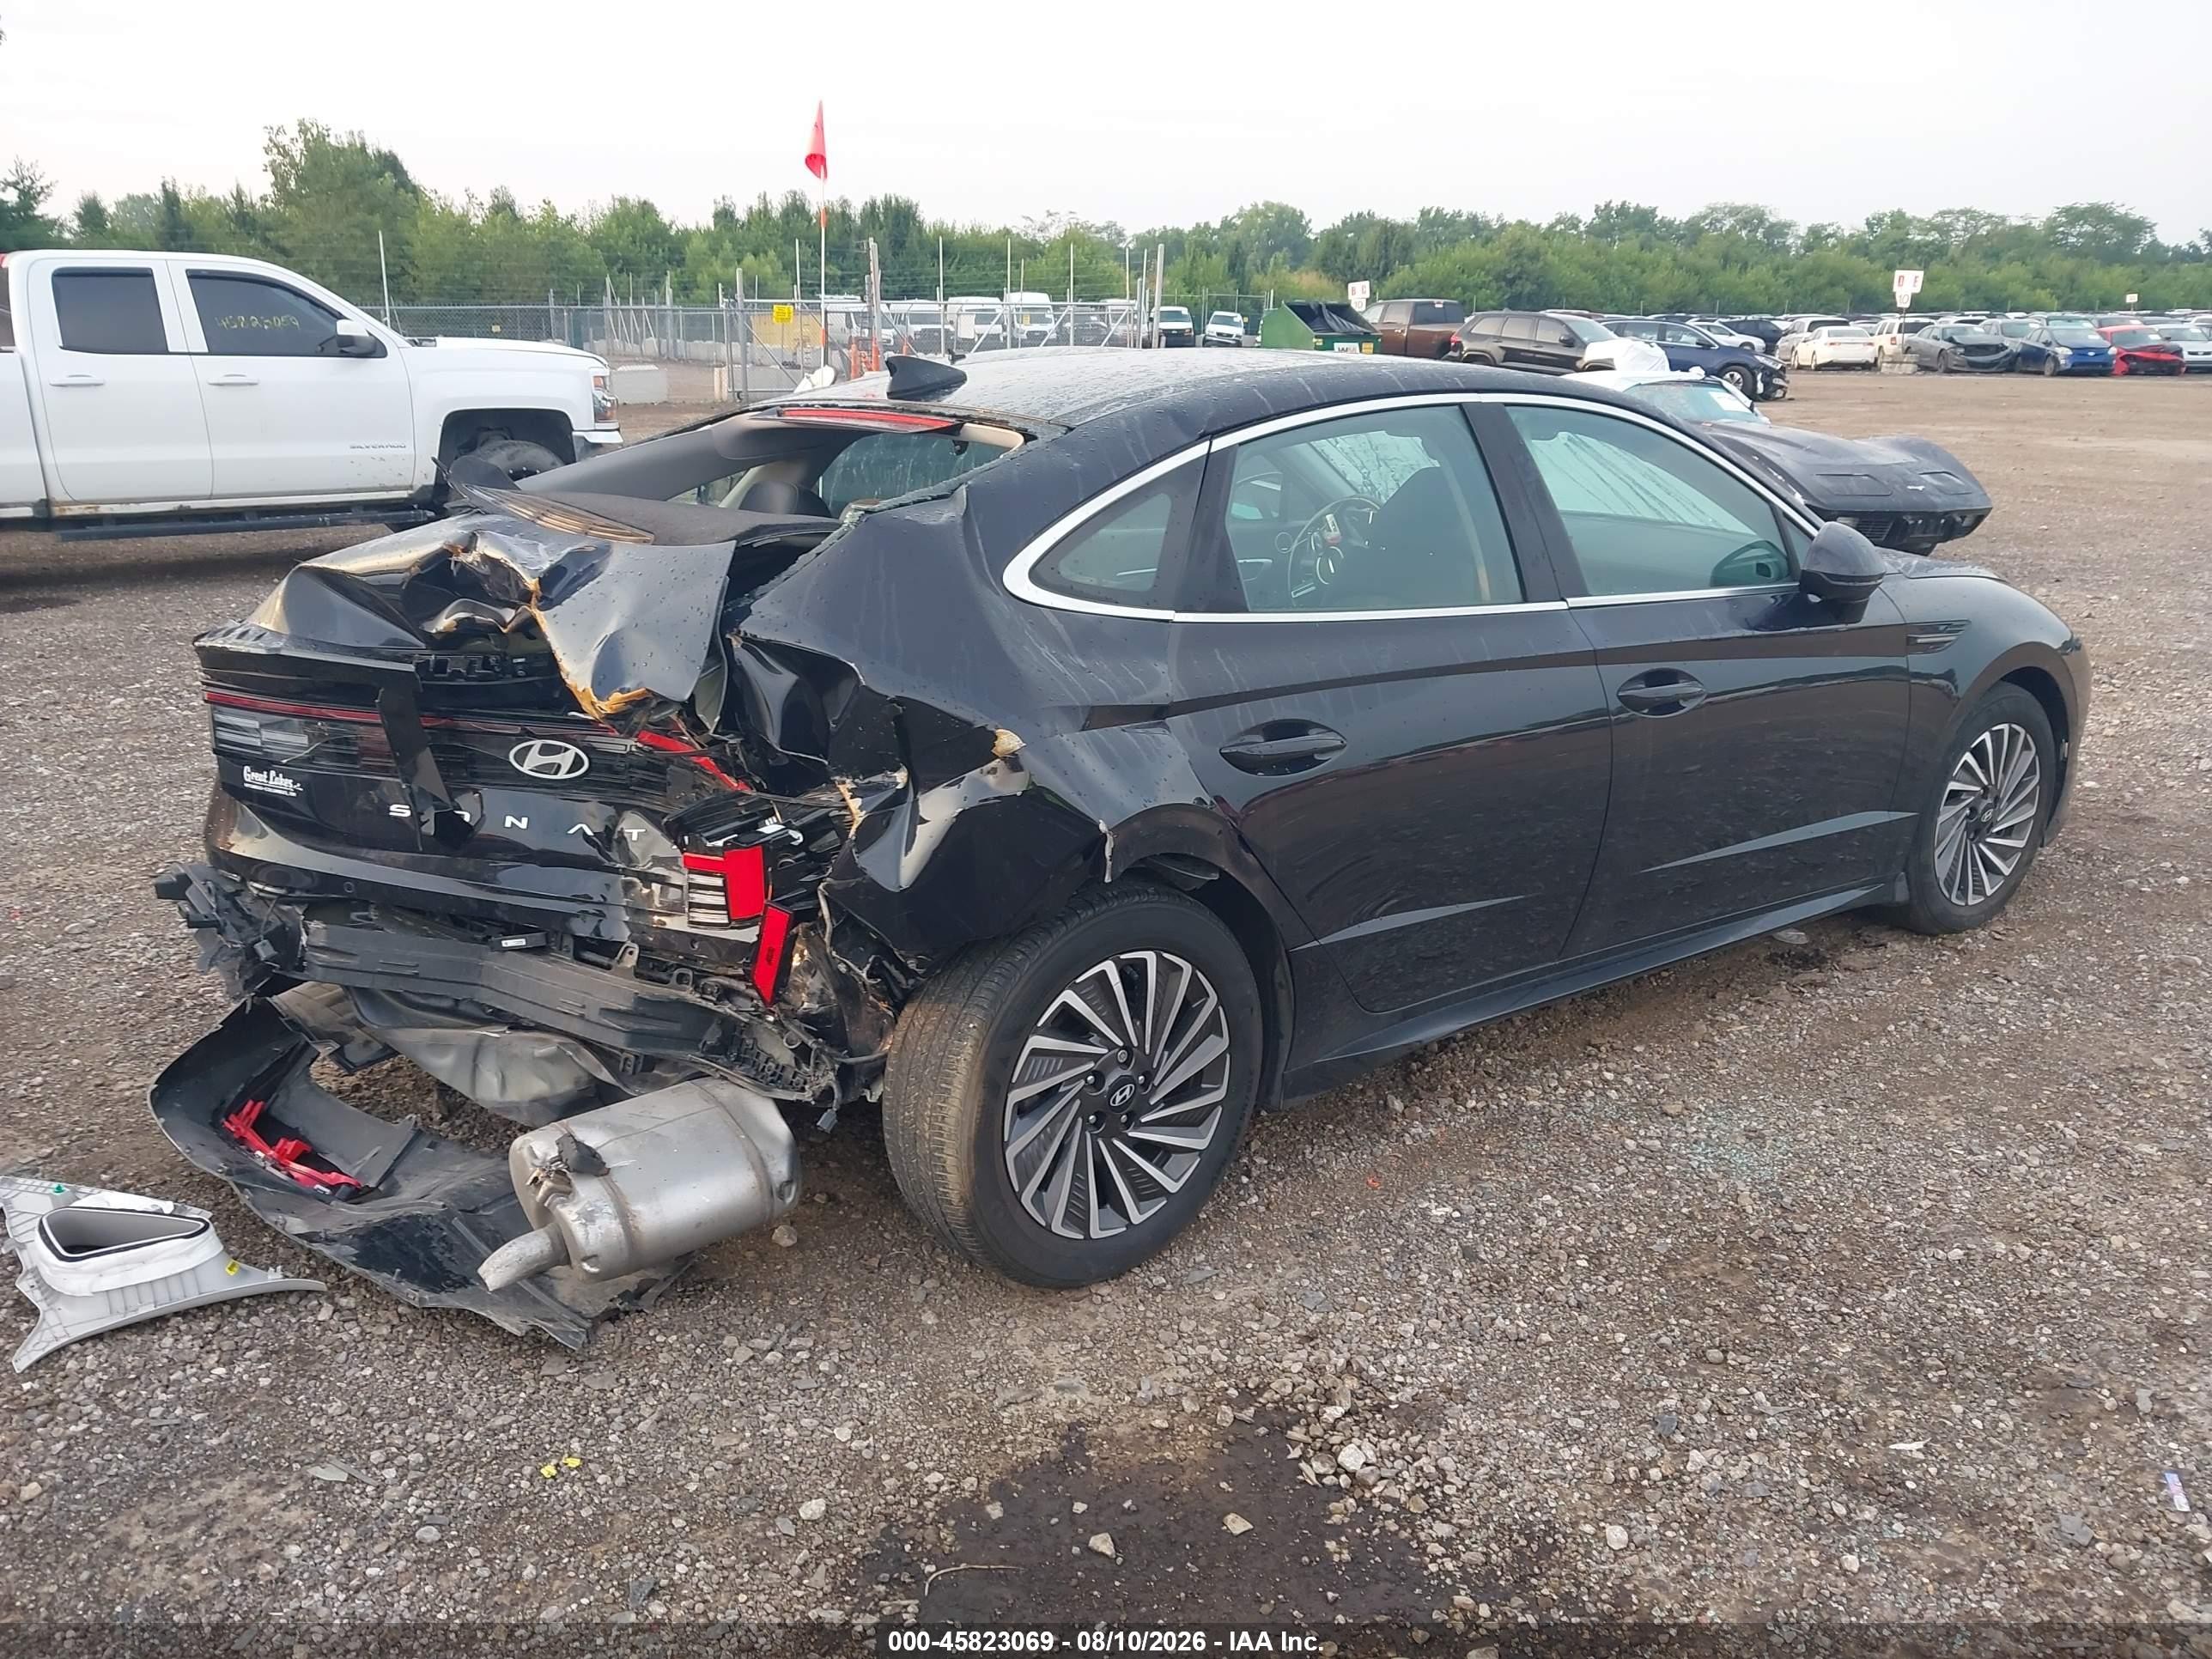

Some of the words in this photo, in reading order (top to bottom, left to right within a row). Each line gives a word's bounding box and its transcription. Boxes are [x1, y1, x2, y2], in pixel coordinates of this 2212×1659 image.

[1898, 294, 1910, 305] 10
[243, 765, 268, 783] Great
[268, 769, 295, 788] Lakes
